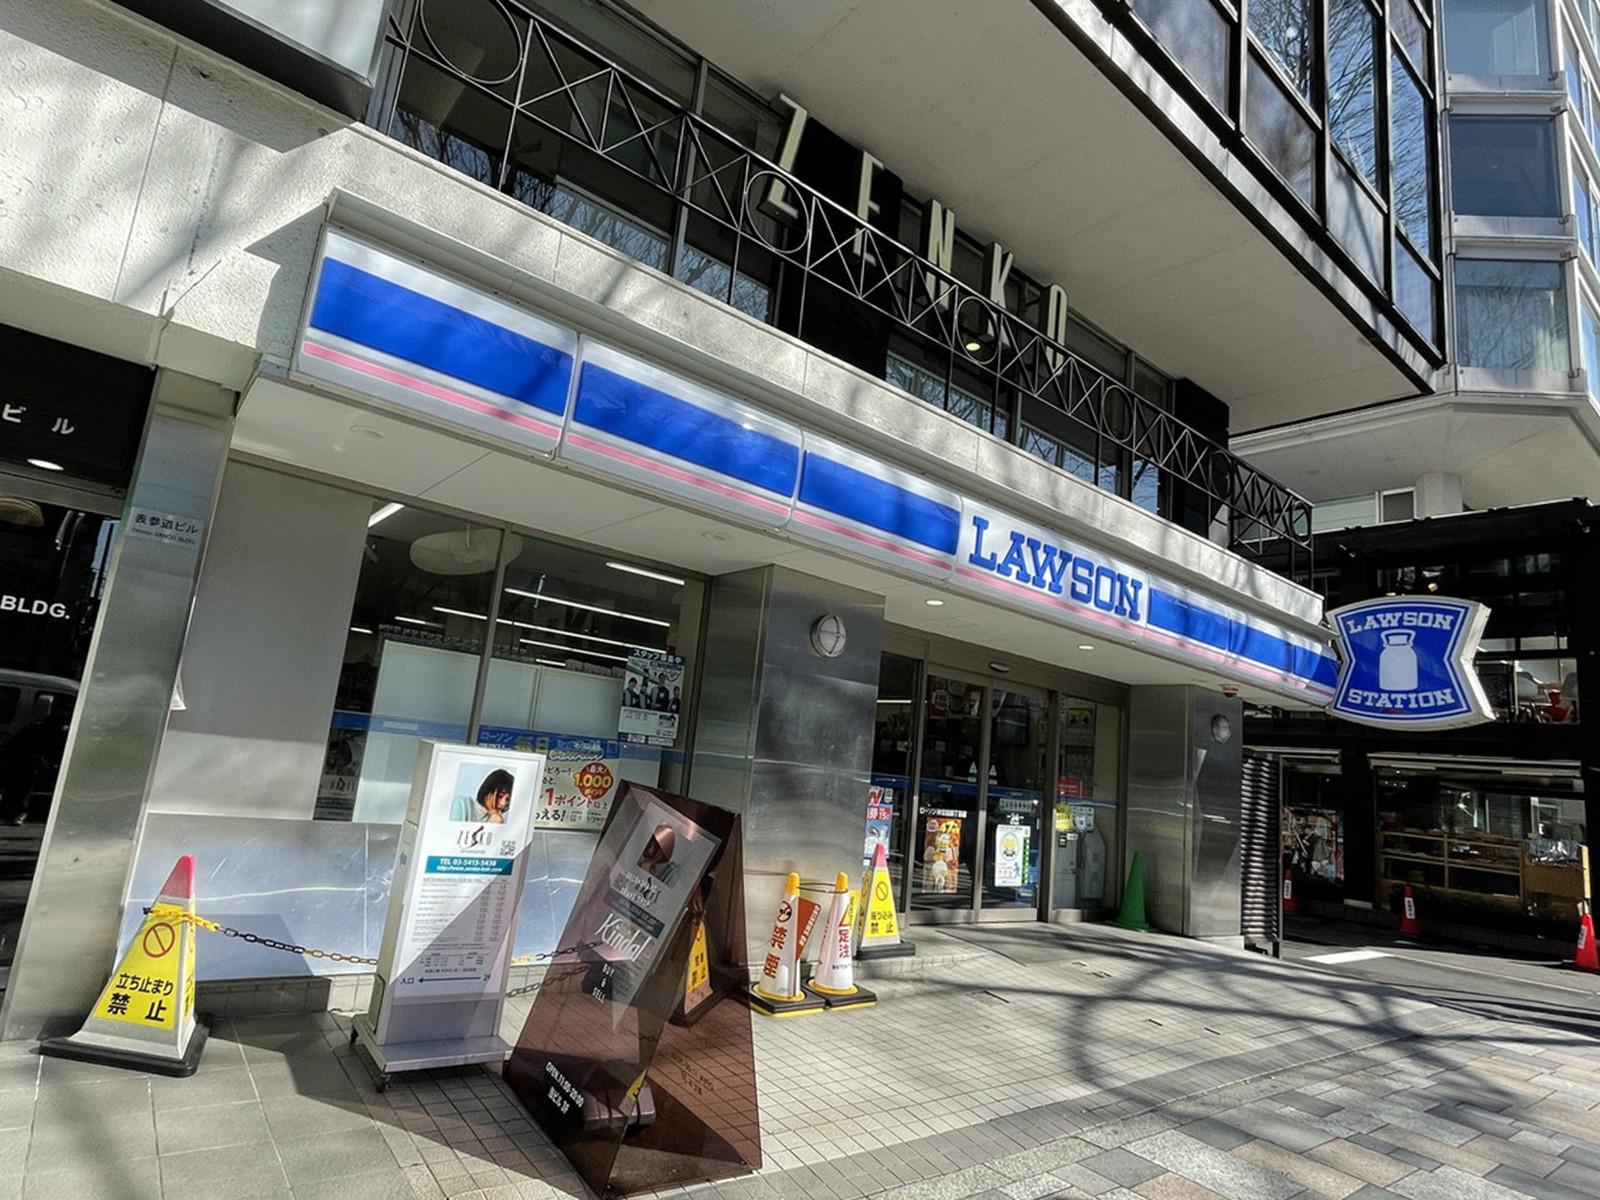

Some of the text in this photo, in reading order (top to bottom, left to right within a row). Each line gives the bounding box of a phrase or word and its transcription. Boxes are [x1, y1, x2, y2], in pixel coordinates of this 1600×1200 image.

[2, 404, 75, 435] ビル
[135, 513, 199, 534] 表参道ビル
[968, 514, 1144, 622] LAWSON
[0, 594, 71, 620] BLDG.
[1346, 611, 1454, 635] LAWSON
[1347, 687, 1455, 709] STATION
[480, 731, 514, 743] ローソン
[594, 912, 652, 962] Kindal
[115, 973, 174, 997] 立ち止まり
[107, 992, 167, 1023] 禁止
